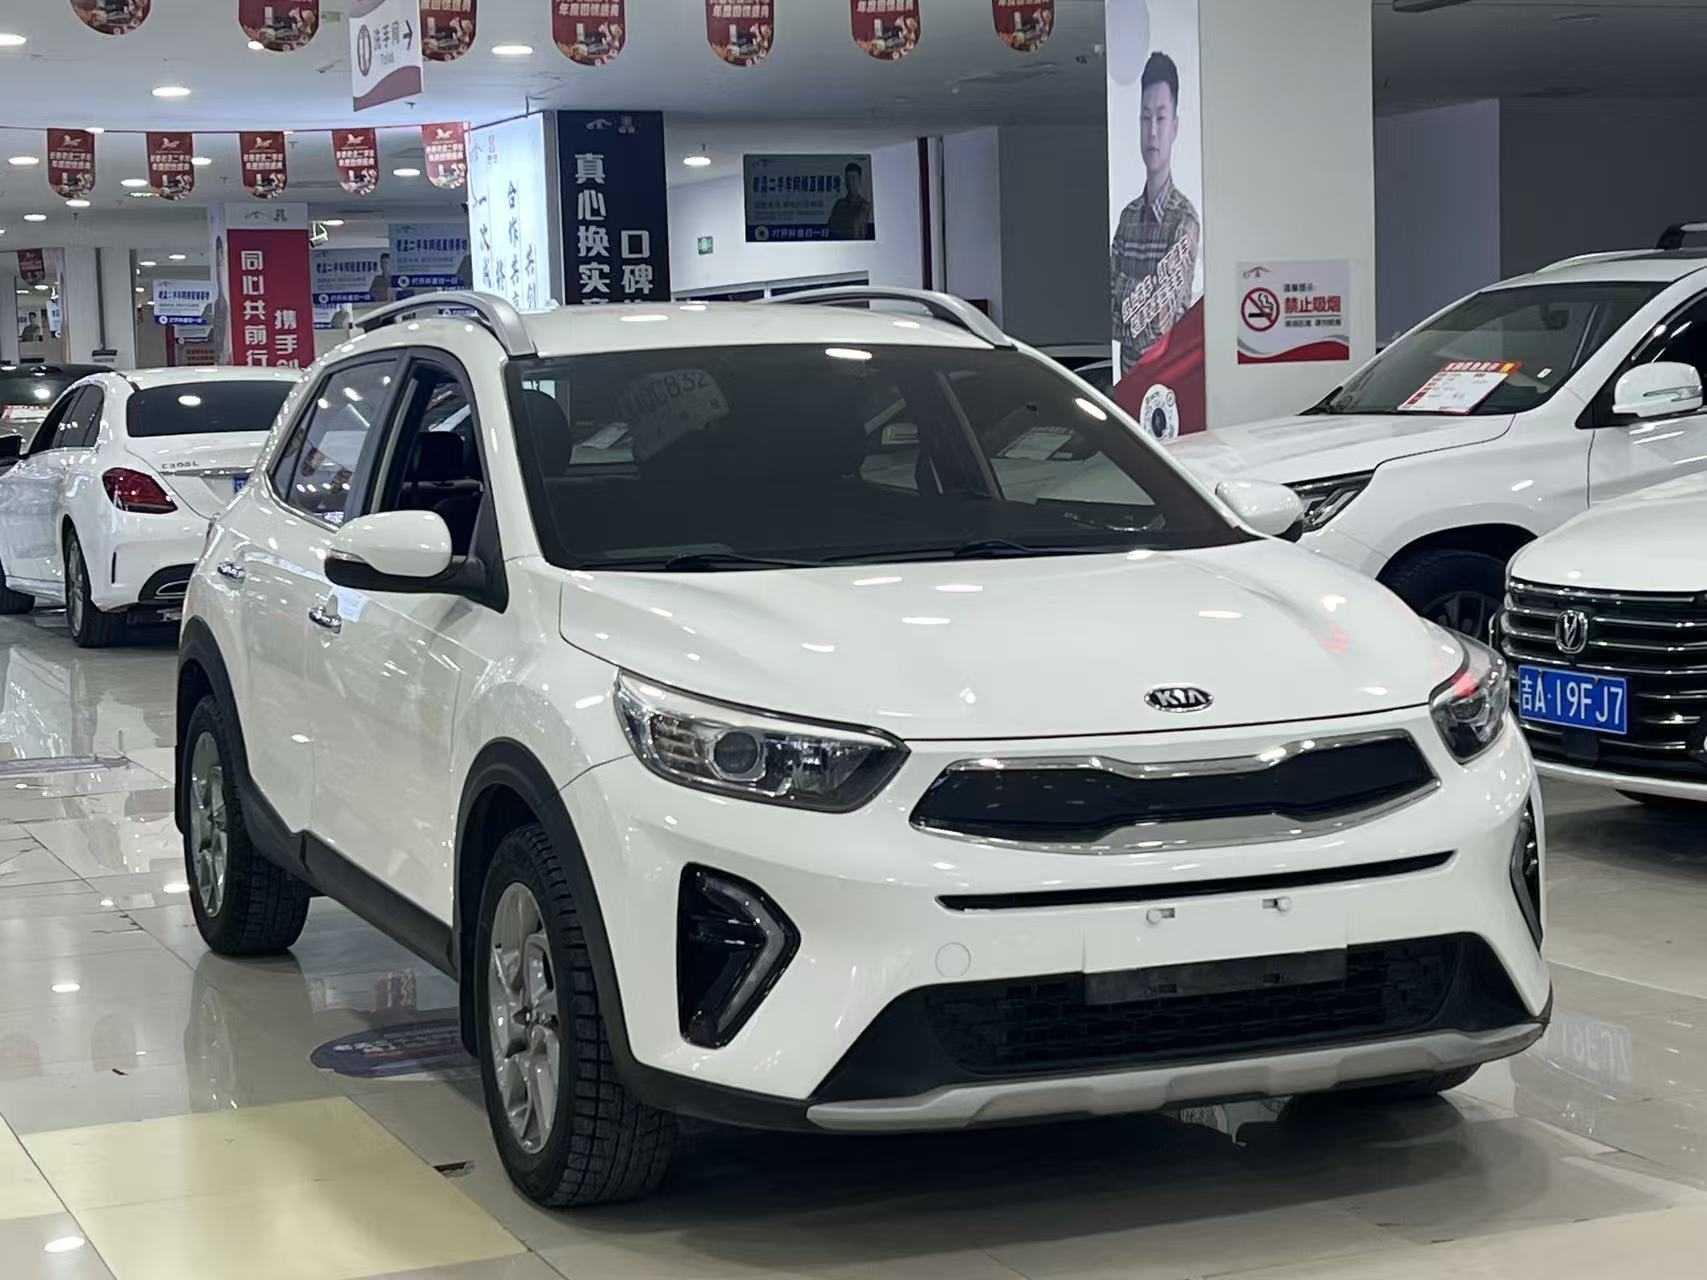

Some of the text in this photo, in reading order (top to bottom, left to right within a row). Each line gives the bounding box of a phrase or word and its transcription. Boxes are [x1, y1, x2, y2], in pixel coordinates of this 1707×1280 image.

[620, 230, 655, 304] 口碑
[240, 250, 268, 367] 同心共前行
[1285, 295, 1342, 314] 禁止吸烟
[1153, 687, 1208, 707] KIA
